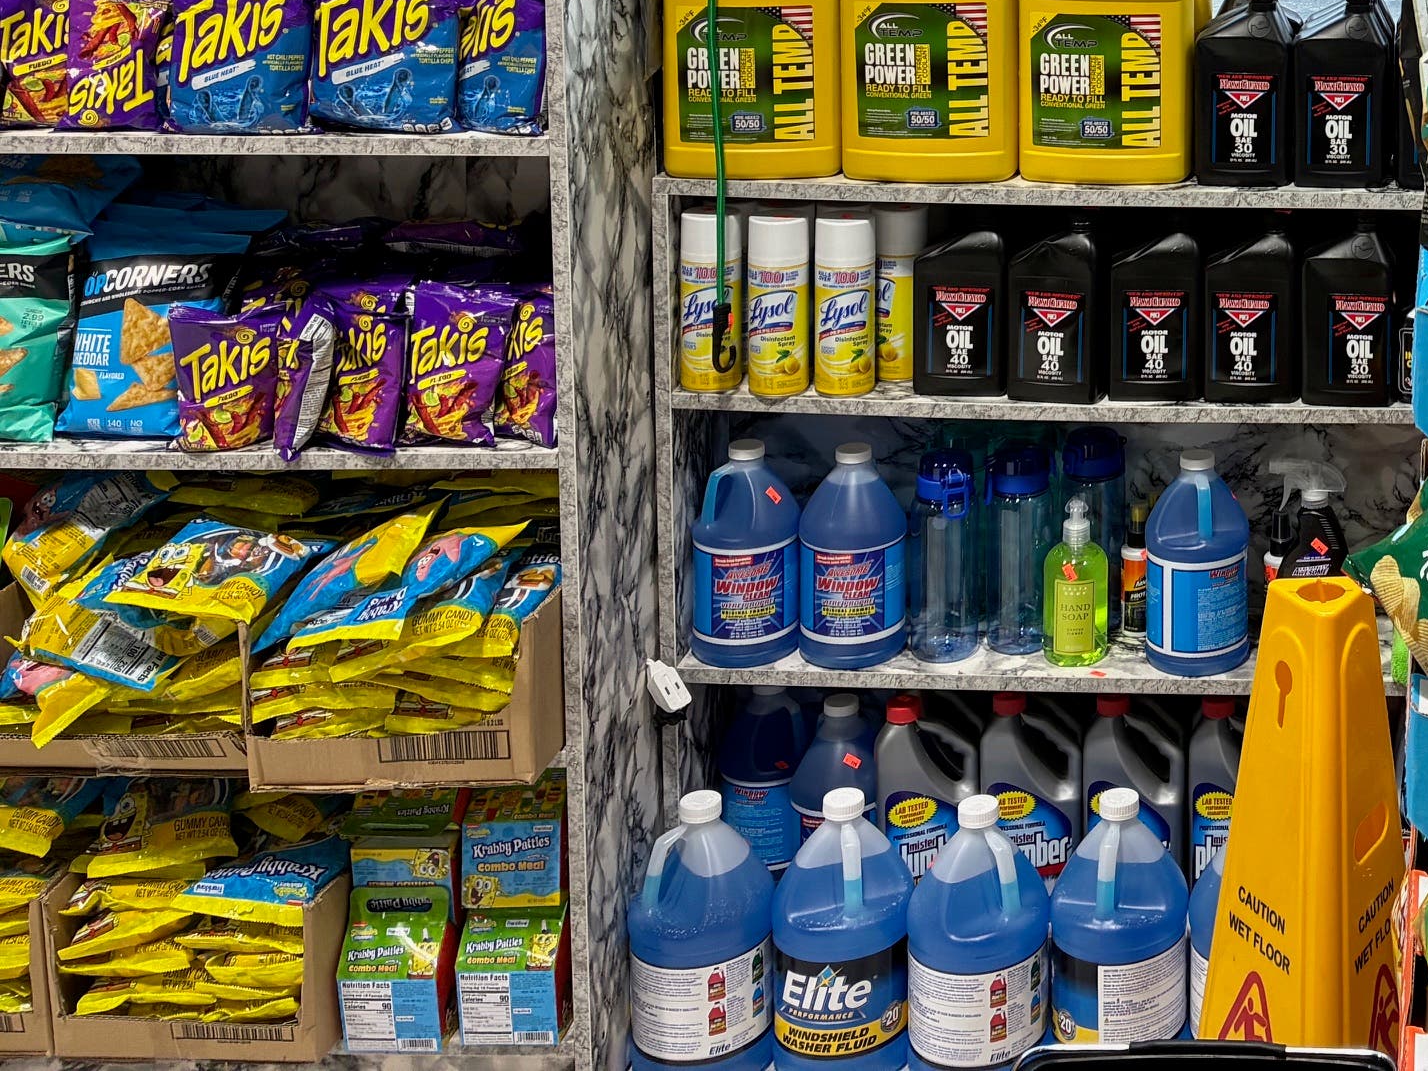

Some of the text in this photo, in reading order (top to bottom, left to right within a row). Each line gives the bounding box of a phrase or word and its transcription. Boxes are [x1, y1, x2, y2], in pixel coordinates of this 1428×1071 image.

[865, 42, 914, 66] GREEN
[1040, 53, 1089, 76] GREEN
[1121, 32, 1161, 102] TEMP
[865, 65, 916, 84] POWER
[946, 20, 989, 136] ALL TEMP
[866, 84, 931, 93] READY TO FILL
[1040, 74, 1090, 95] POWER
[1040, 94, 1106, 104] READY TO FILL
[910, 116, 935, 124] 50/50
[1230, 119, 1257, 137] OIL
[1084, 125, 1108, 134] 50/50
[1325, 120, 1352, 139] OIL
[1234, 143, 1253, 153] 30
[1329, 145, 1347, 154] 30
[750, 292, 793, 326] Lysol
[819, 292, 868, 327] Lysol
[834, 334, 869, 343] Disinfectant
[946, 331, 974, 350] OIL
[1230, 338, 1258, 357] OIL
[1346, 340, 1373, 359] OIL
[949, 355, 968, 365] 40
[1233, 361, 1252, 372] 40
[1351, 364, 1369, 375] 30
[107, 419, 121, 427] 140
[716, 576, 779, 594] WINDOW
[817, 575, 879, 592] WINDOW
[1060, 603, 1091, 612] HAND
[412, 609, 476, 627] GUMMY CANDY
[137, 659, 160, 683] Facts
[906, 802, 929, 814] TESTED
[472, 834, 551, 860] Krabby Patties
[909, 838, 936, 852] mister
[477, 860, 545, 873] Combo Meal
[1237, 885, 1286, 936] CAUTION
[1358, 878, 1395, 934] CAUTION
[465, 936, 523, 954] Krabby Patties
[1229, 911, 1291, 976] WET FLOOR
[347, 945, 405, 962] Krabby Patties
[466, 956, 494, 965] Combo
[1353, 943, 1374, 975] WET
[348, 964, 376, 974] Combo
[459, 973, 509, 982] Nutrition Facts
[342, 981, 391, 989] Nutrition Facts
[783, 972, 872, 1011] Elite
[381, 1002, 392, 1010] 90
[499, 994, 510, 1003] 90
[788, 1006, 855, 1020] PERFORMANCE
[789, 1026, 869, 1040] WINDSHIELD
[709, 1042, 731, 1056] Elite
[783, 1035, 877, 1053] WASHER FLUID
